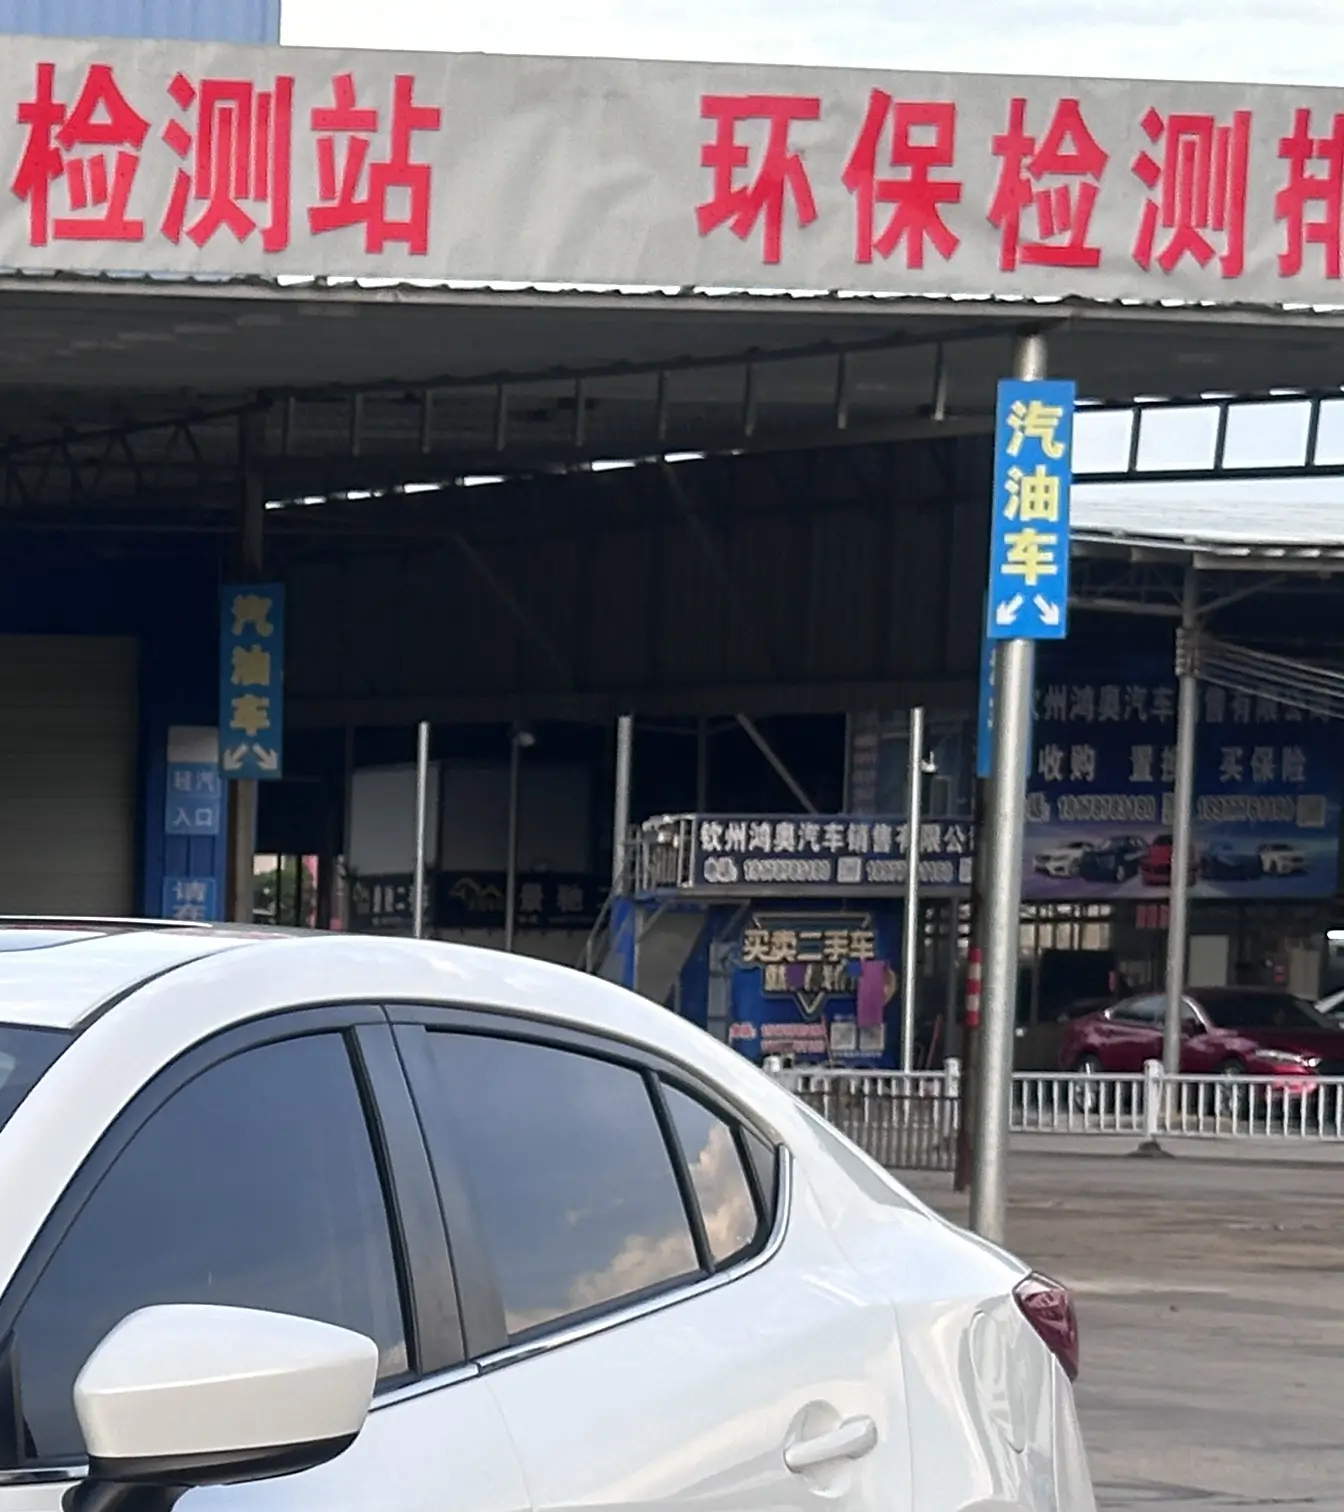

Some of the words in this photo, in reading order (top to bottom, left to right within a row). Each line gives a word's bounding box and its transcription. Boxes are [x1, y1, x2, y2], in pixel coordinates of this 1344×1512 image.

[1000, 399, 1065, 586] 汽油车
[230, 593, 274, 738] 汽油车
[1038, 744, 1097, 783] 收购
[1219, 744, 1307, 784] 买保险
[172, 807, 213, 827] 入口
[743, 929, 875, 962] 买卖二手车
